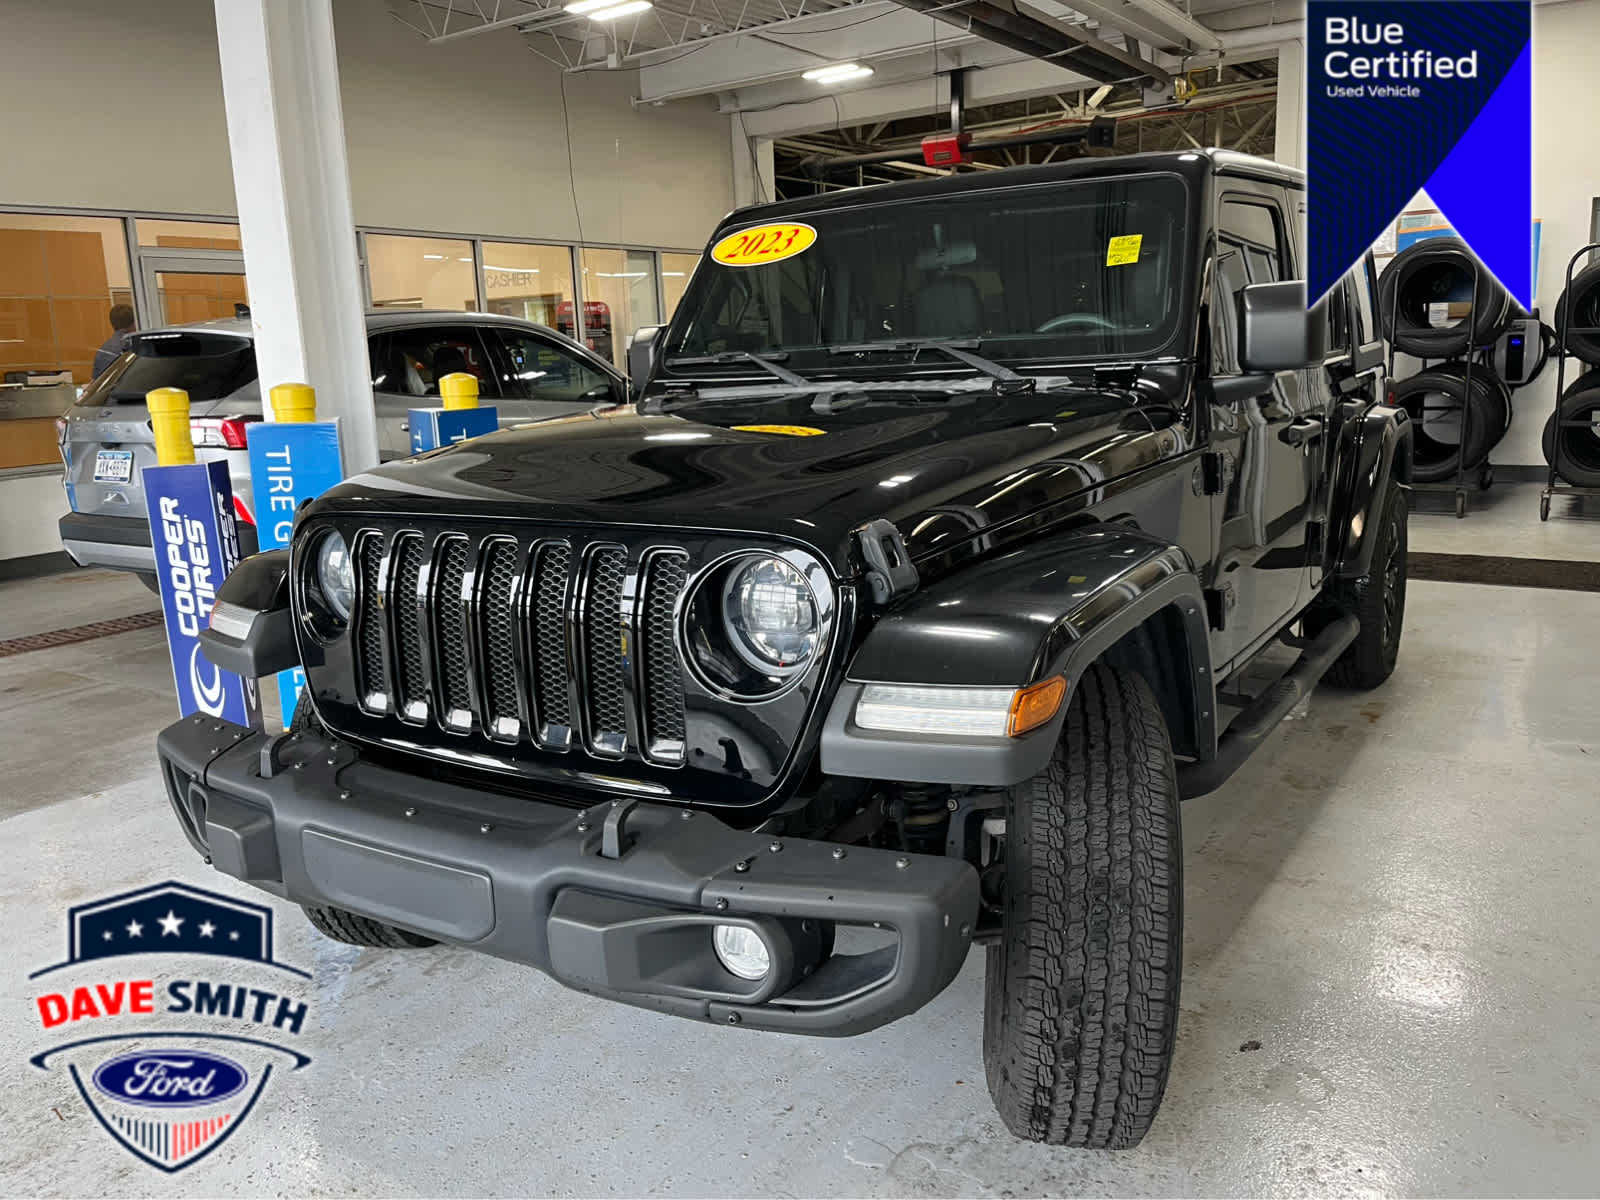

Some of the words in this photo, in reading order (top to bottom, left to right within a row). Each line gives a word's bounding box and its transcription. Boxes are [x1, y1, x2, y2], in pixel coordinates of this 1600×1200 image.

[725, 228, 800, 258] 2023
[487, 272, 532, 288] CASHIER
[265, 444, 296, 512] TIRE
[160, 496, 199, 637] COOPER
[186, 518, 216, 618] TIRES
